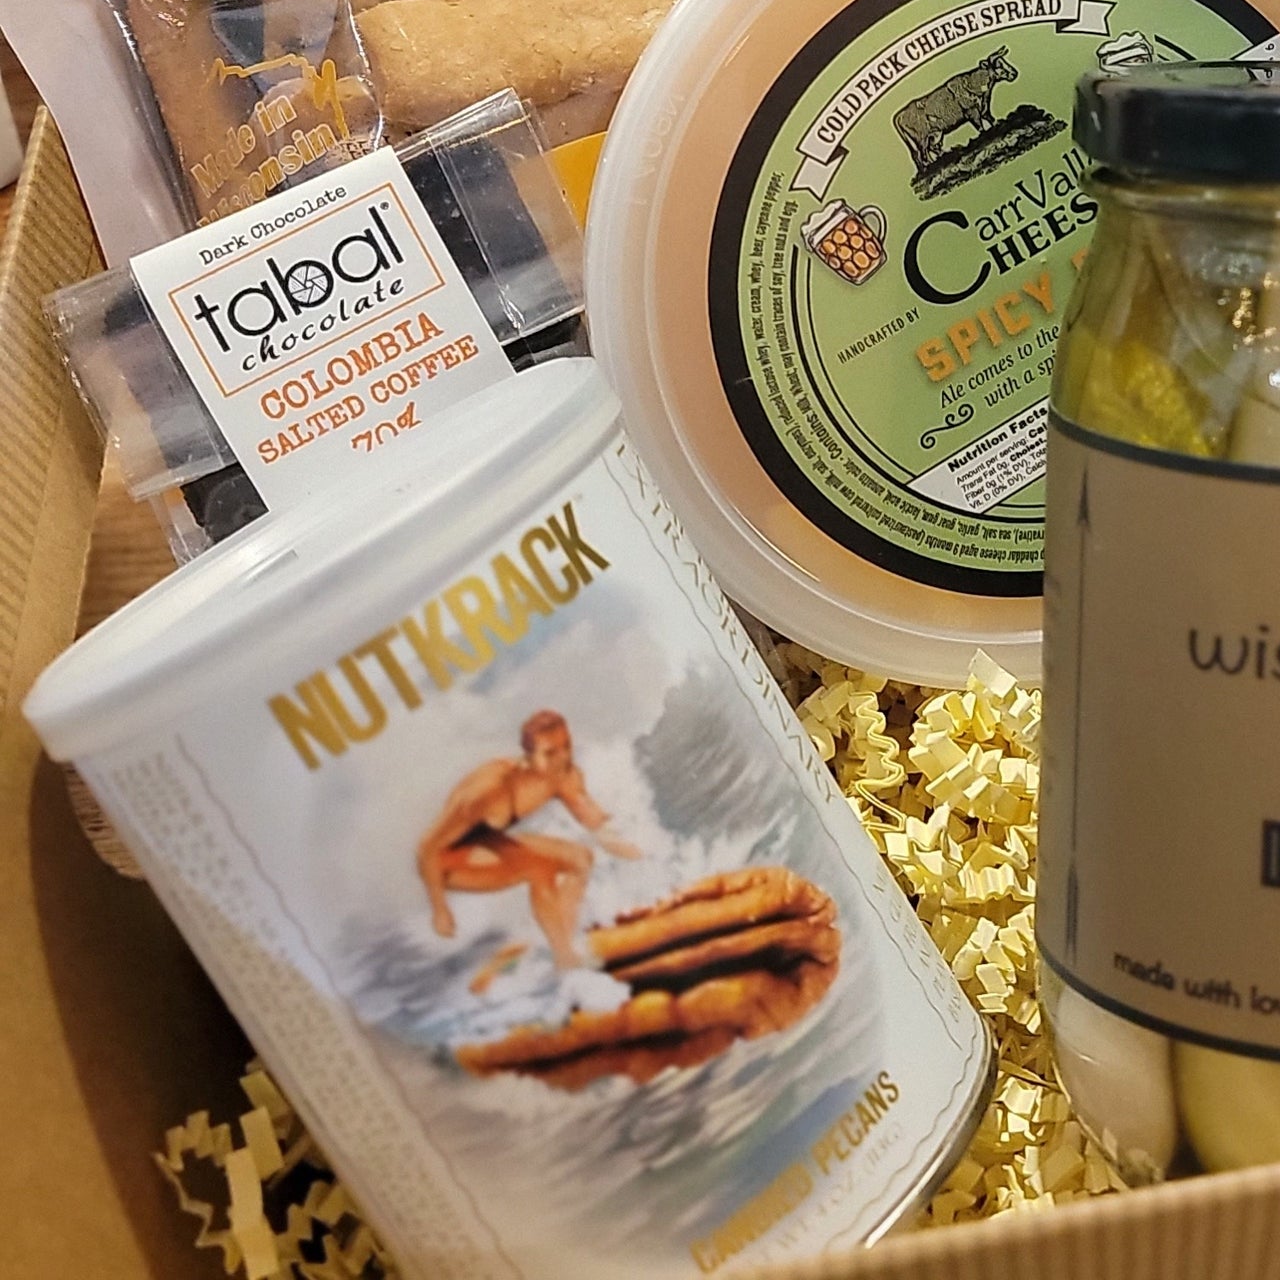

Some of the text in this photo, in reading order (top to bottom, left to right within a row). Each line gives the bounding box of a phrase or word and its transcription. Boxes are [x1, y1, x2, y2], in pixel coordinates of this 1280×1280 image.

[817, 91, 862, 144] COLD
[860, 55, 906, 100] PACK
[905, 12, 979, 61] CHEESE
[255, 96, 298, 136] in
[199, 183, 348, 266] Dark Chocolate
[193, 205, 405, 353] tabal
[242, 277, 405, 373] chocolate
[837, 307, 922, 364] HANDCRAFTED BY
[915, 273, 1055, 384] SPICY
[260, 311, 445, 420] COLOMBIA
[939, 325, 1060, 409] Ale comes to the
[984, 368, 1036, 410] with a
[256, 335, 480, 465] SALTED COFFEE
[948, 430, 1008, 473] Nutrition
[1009, 406, 1049, 434] Facts
[956, 463, 986, 485] Amount
[986, 455, 1000, 468] per
[962, 476, 984, 492] Trans
[983, 468, 997, 478] Fat
[965, 486, 986, 501] Fiber
[959, 545, 979, 557] aged
[980, 548, 1006, 563] cheese
[1008, 551, 1039, 564] cheddar
[265, 503, 610, 773] NUTKRACK
[1114, 952, 1175, 991] made
[1184, 979, 1241, 1009] with
[809, 1070, 900, 1176] PECANS
